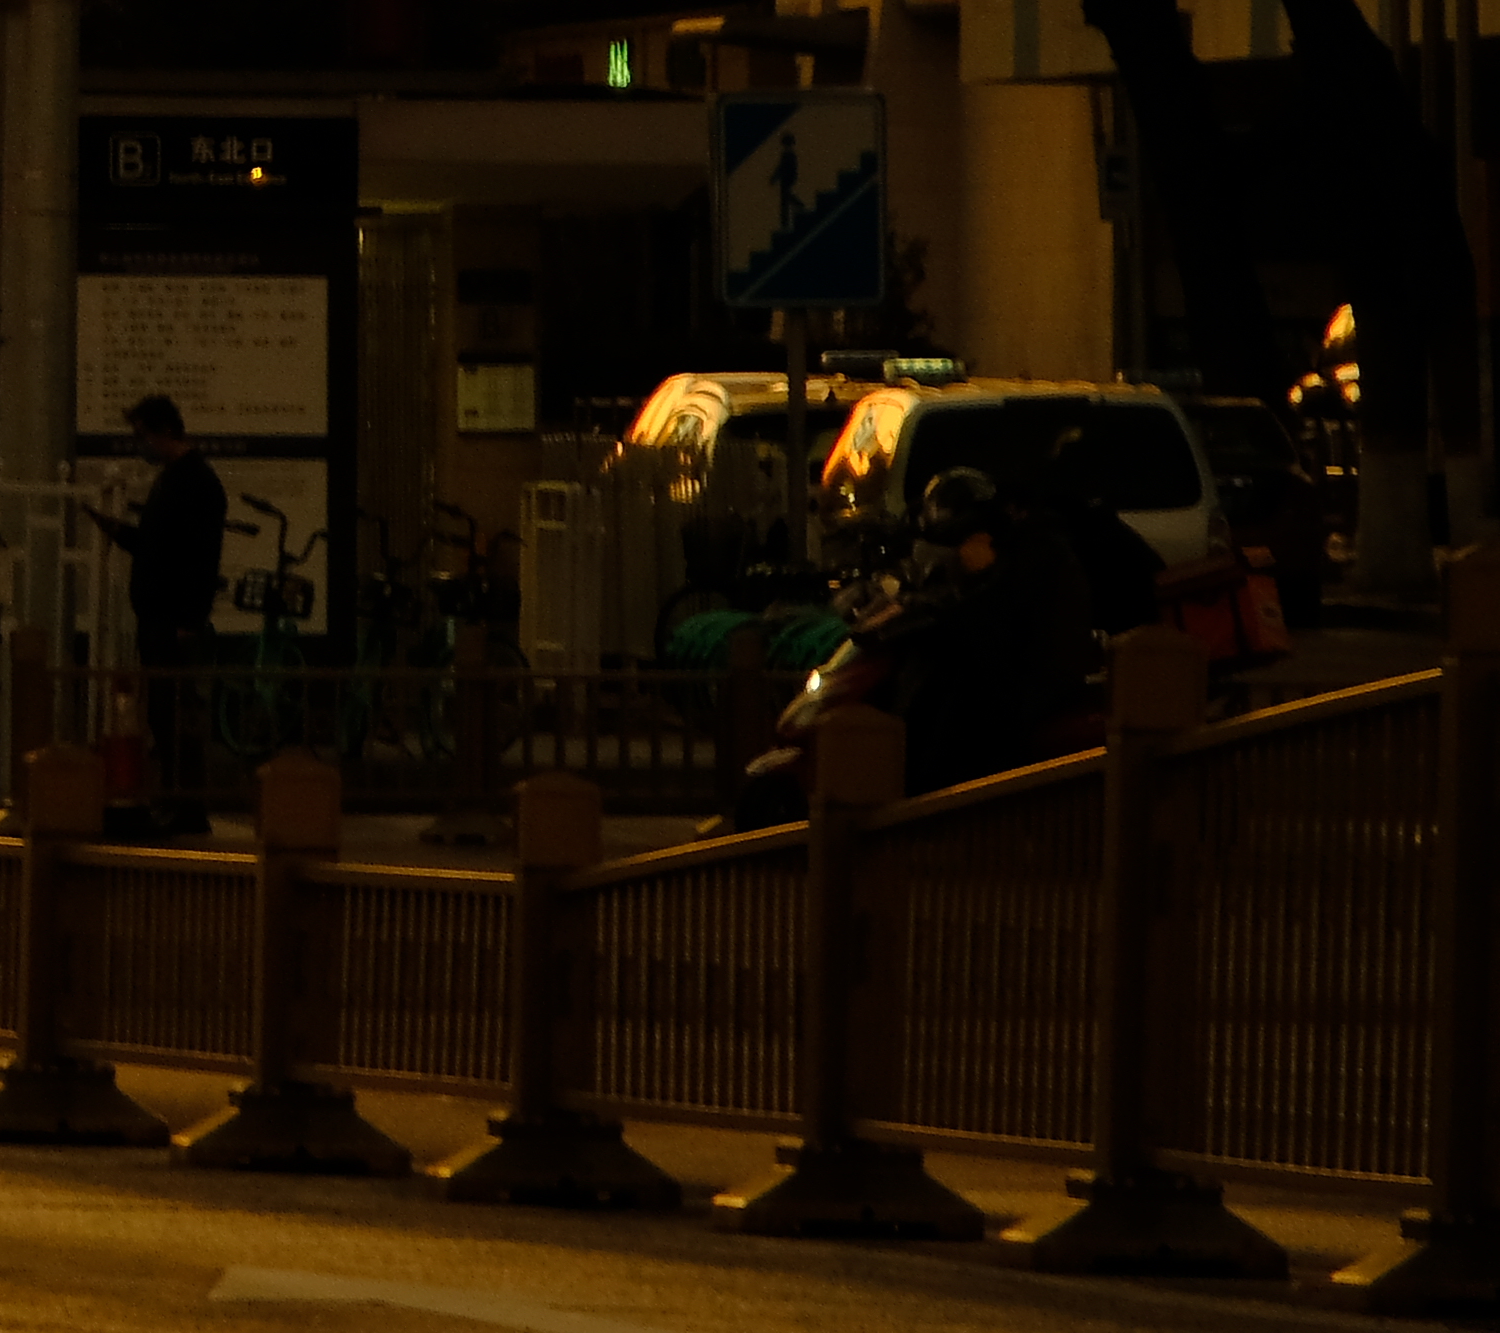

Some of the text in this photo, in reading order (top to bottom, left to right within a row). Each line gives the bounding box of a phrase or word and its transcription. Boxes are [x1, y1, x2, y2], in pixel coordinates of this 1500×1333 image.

[118, 138, 144, 181] B
[189, 134, 275, 165] 东北口
